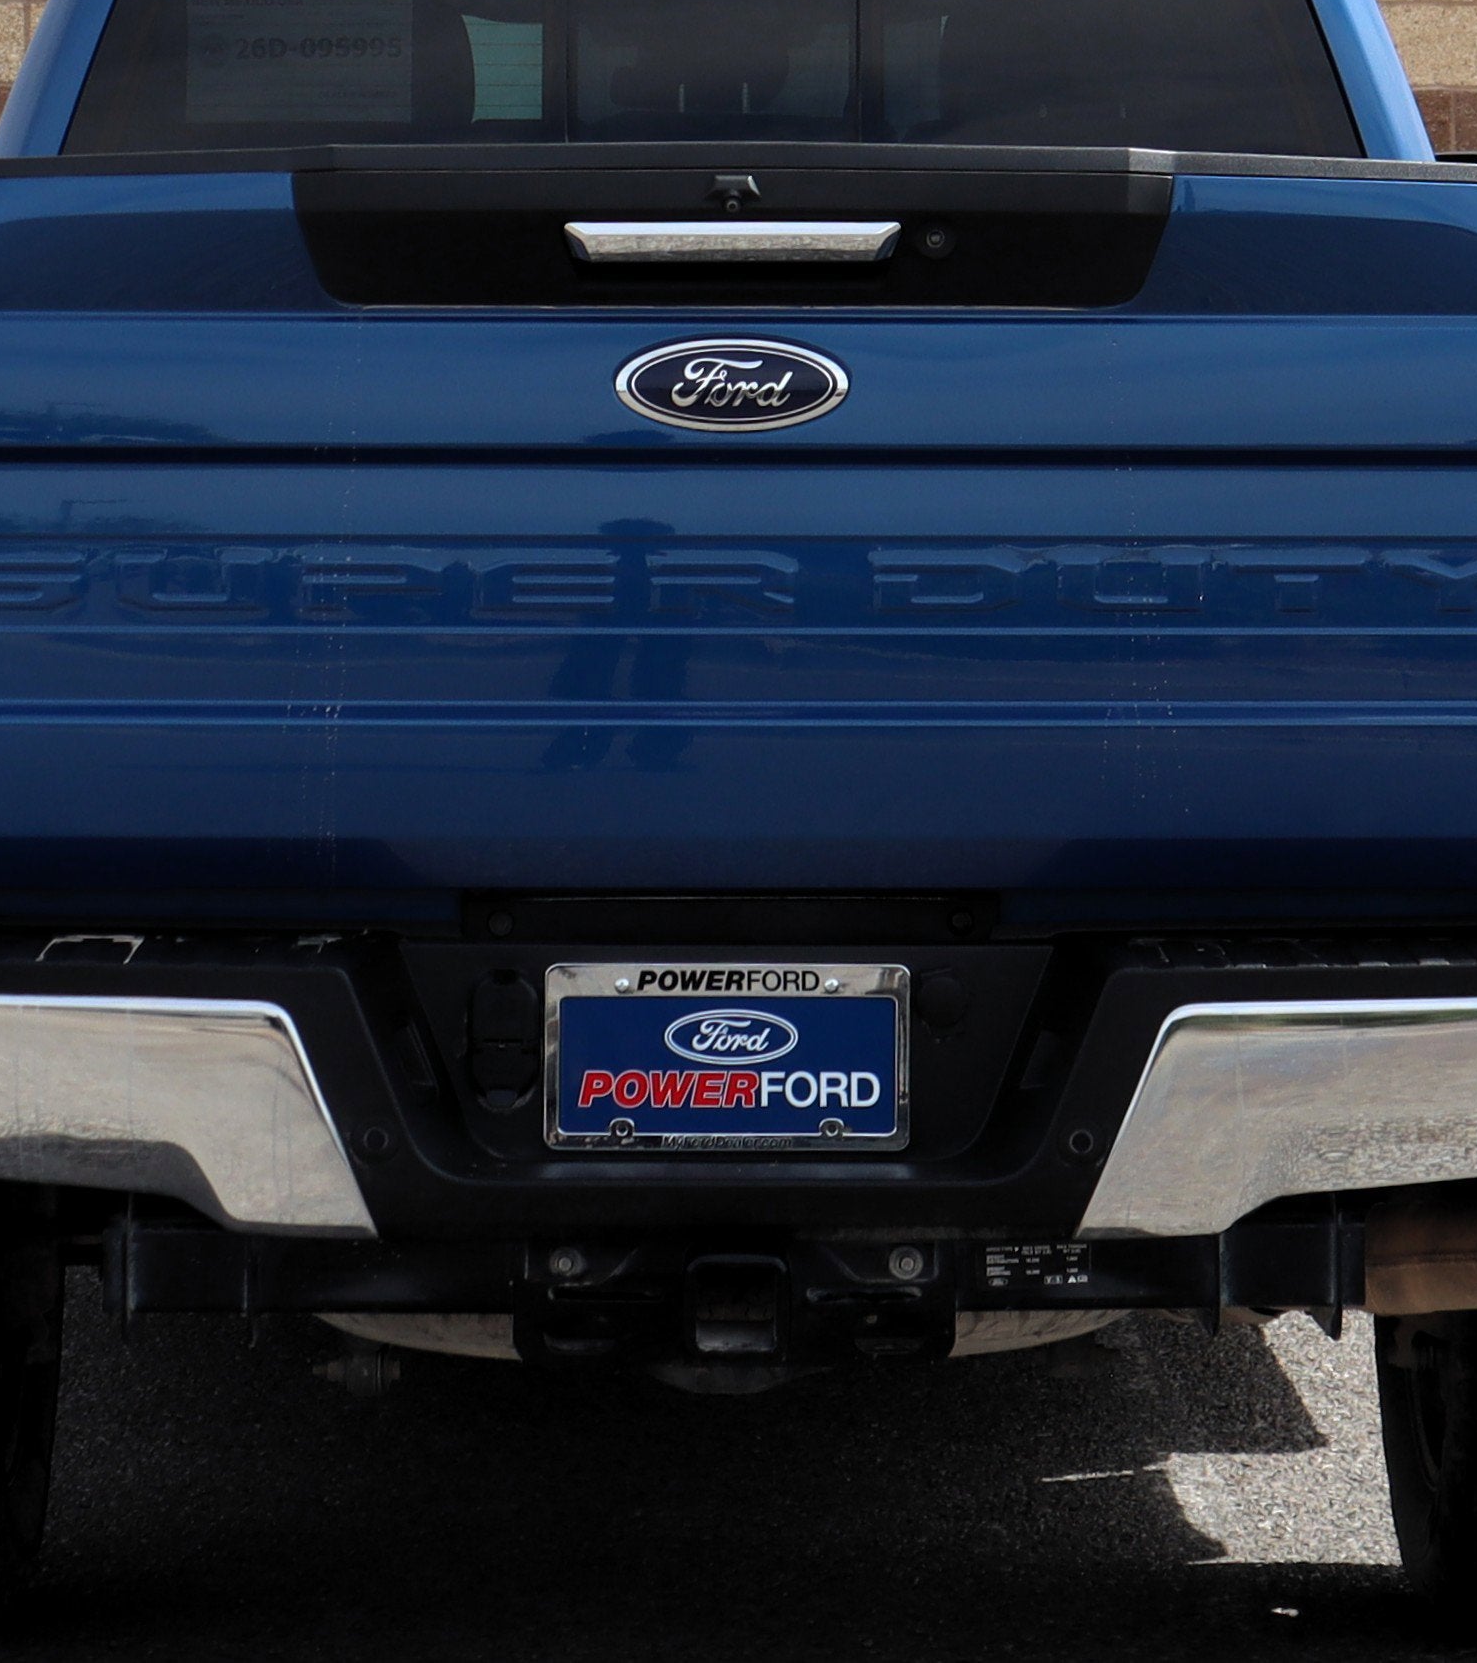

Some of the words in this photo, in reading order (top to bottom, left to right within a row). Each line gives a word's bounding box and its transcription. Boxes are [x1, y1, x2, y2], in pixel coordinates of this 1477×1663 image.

[671, 357, 794, 408] Ford
[636, 970, 821, 992] POWERFORD
[691, 1019, 771, 1052] Ford
[578, 1069, 882, 1108] POWERFORD
